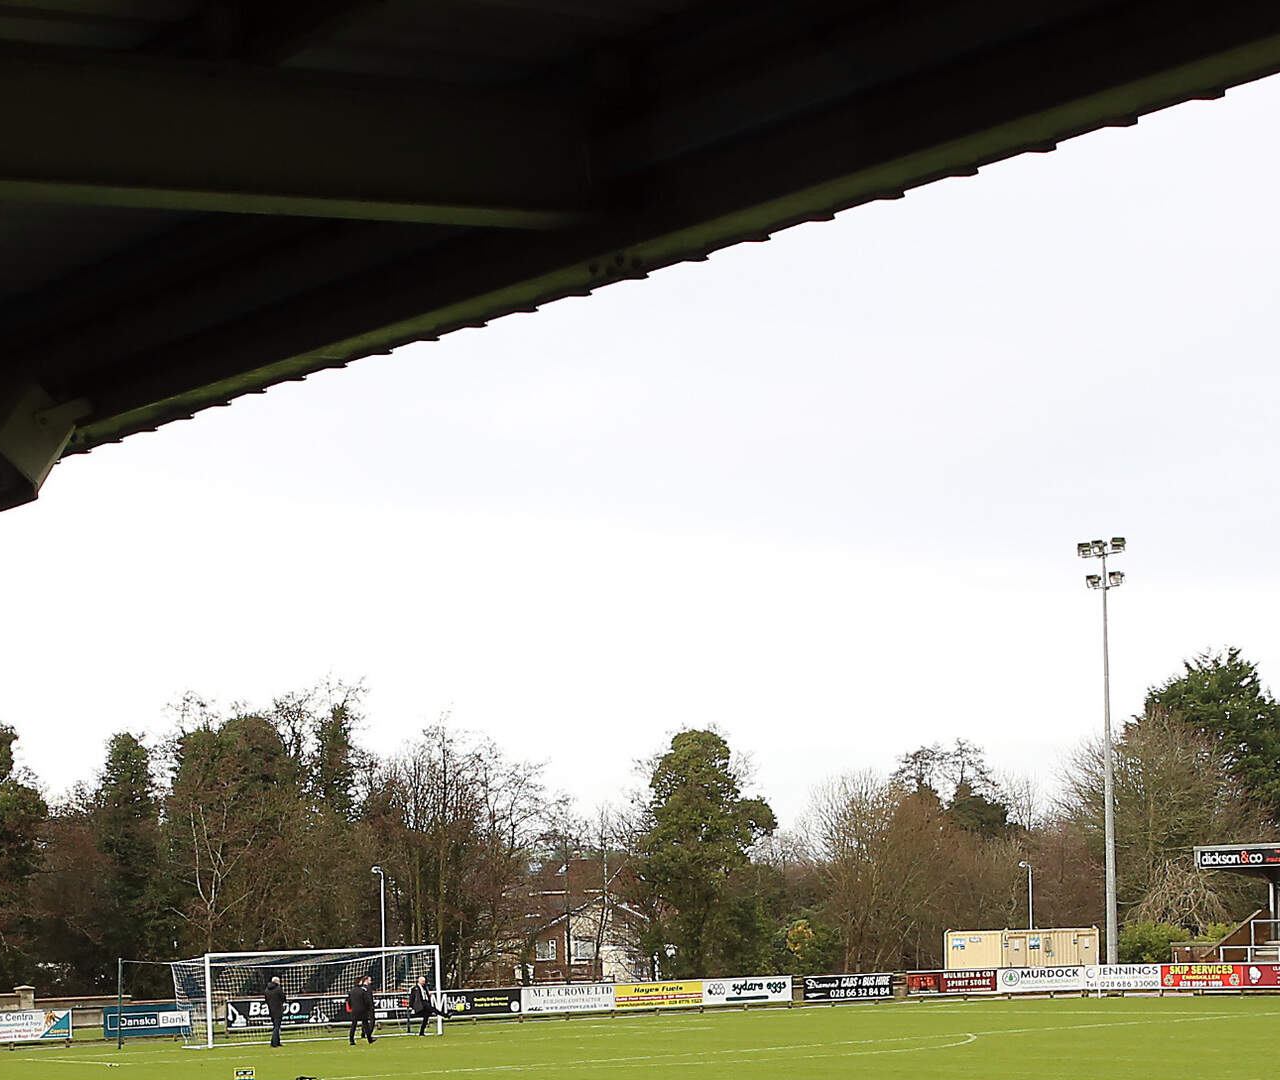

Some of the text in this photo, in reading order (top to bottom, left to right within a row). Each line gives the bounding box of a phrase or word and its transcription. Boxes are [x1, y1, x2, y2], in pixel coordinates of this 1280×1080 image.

[1201, 850, 1264, 865] dickson&co
[1021, 969, 1079, 979] MURDOCK
[1098, 966, 1159, 975] JENNINGS
[1170, 964, 1233, 975] SKIP SERVICES
[841, 977, 858, 987] CABS
[862, 977, 876, 986] BUS
[876, 976, 891, 985] HIRE
[947, 978, 991, 987] SPIRIT STORE
[557, 987, 592, 996] CROWE
[594, 986, 613, 995] LTD
[634, 986, 661, 995] Hayes
[732, 980, 787, 995] sydare eggs
[830, 985, 890, 998] 028 66 32 84 84
[5, 1012, 34, 1021] Centra
[161, 1013, 189, 1024] Bank
